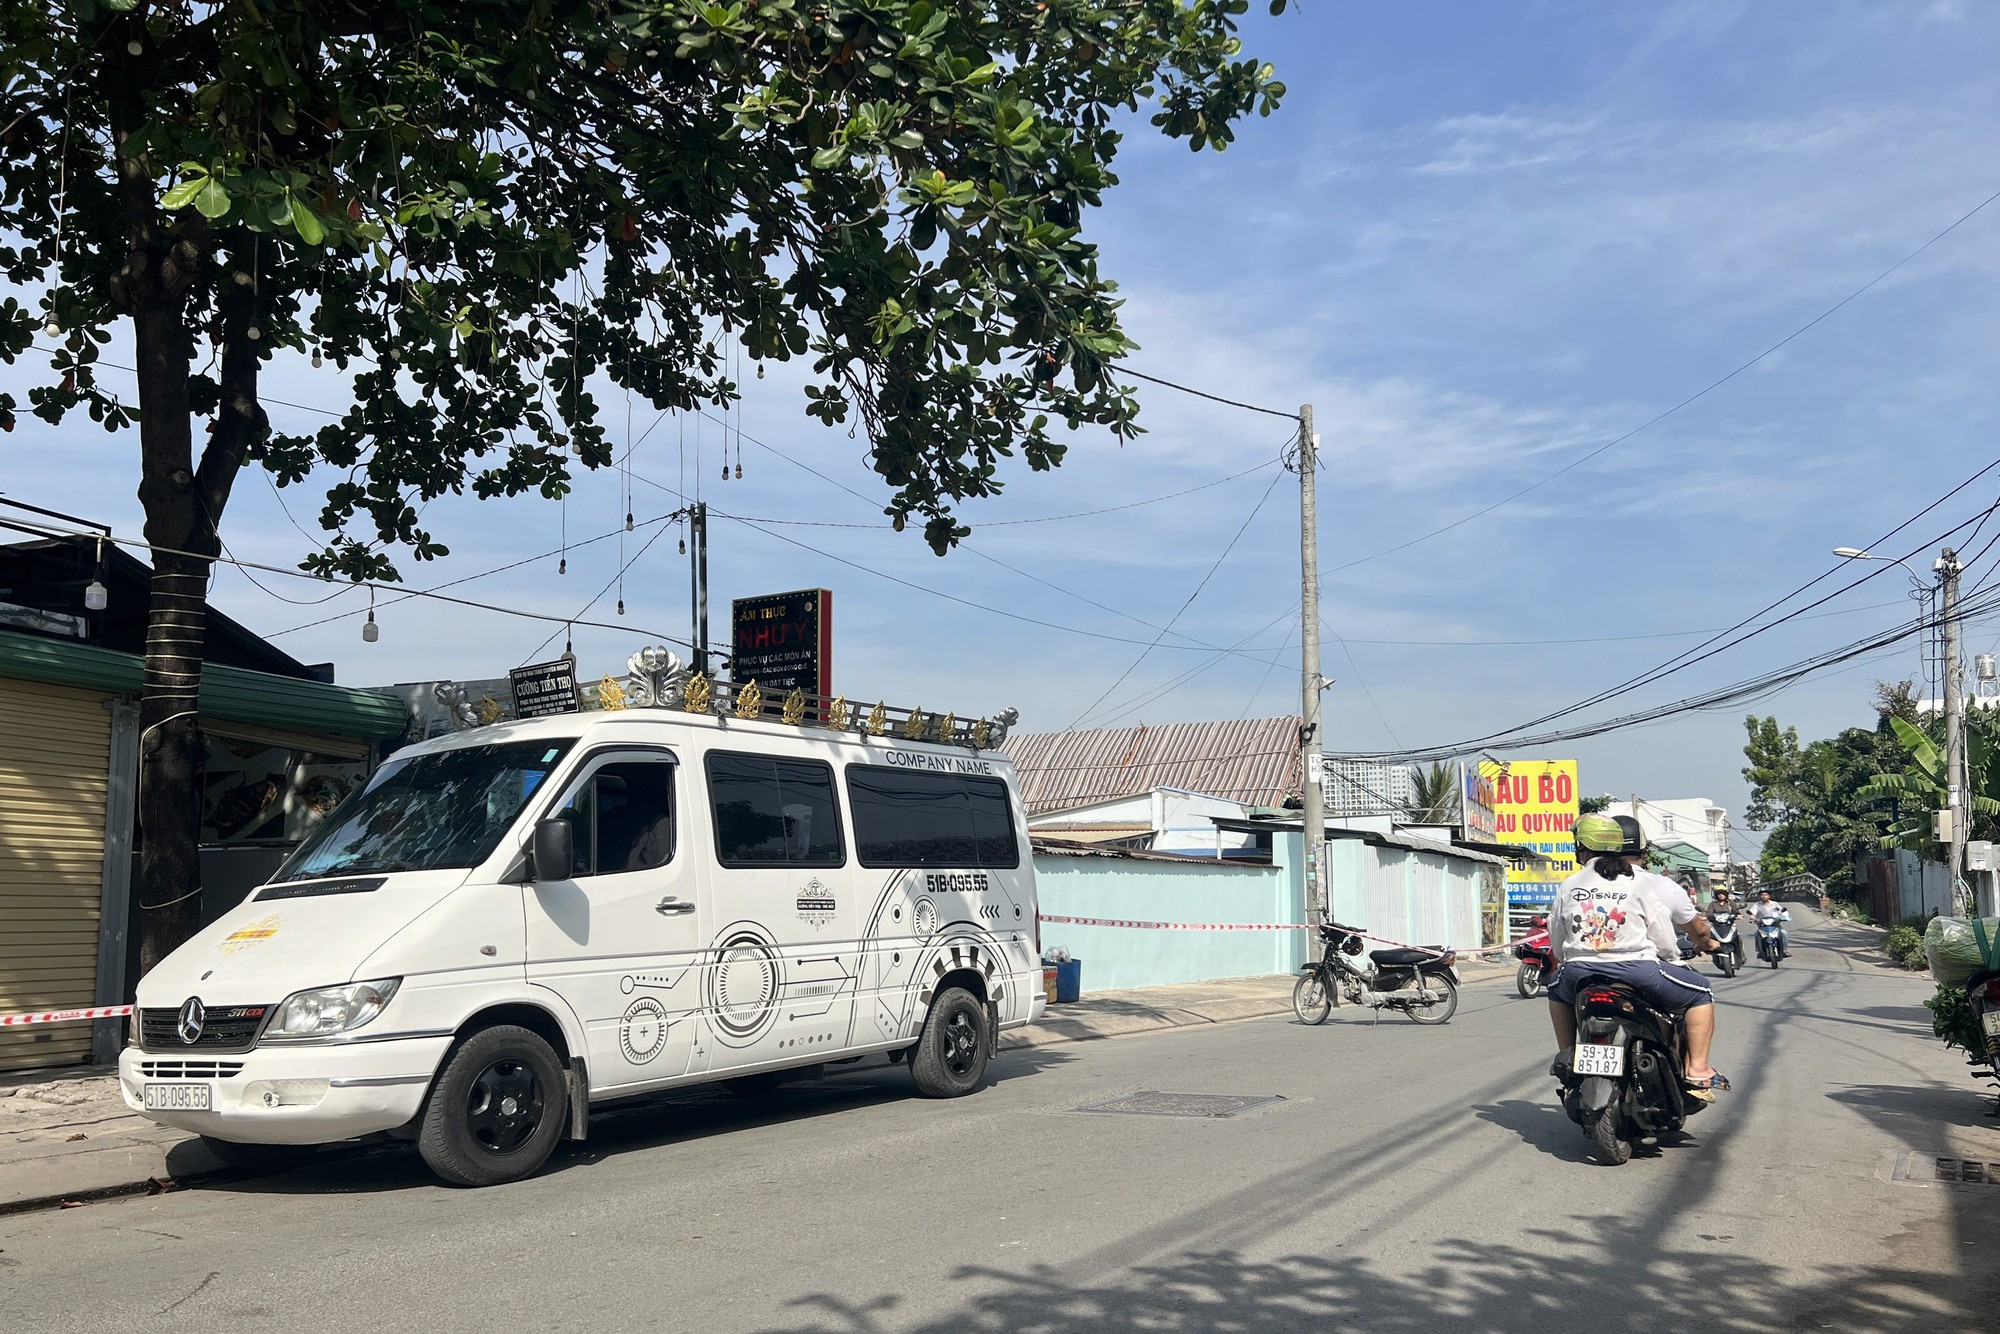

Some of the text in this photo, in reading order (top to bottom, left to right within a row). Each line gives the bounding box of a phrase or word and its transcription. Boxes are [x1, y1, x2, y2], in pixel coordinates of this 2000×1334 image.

[760, 605, 786, 619] THỰC
[738, 623, 790, 649] NHƯ
[739, 656, 757, 666] PHỤC
[758, 655, 768, 665] VỤ
[769, 652, 783, 662] CÁC
[784, 650, 800, 660] MÓN
[516, 673, 571, 696] CƯỜNG TIẾN THỌ
[886, 751, 991, 775] COMPANY NAME
[1494, 765, 1528, 804] ẨU
[1538, 770, 1572, 803] BÒ
[1495, 811, 1516, 832] ÁU
[1522, 810, 1574, 834] QUỲNH
[1540, 842, 1553, 853] RAU
[1552, 860, 1573, 871] CHI
[1582, 1045, 1616, 1060] 59-X3
[1577, 1059, 1618, 1074] 851.87
